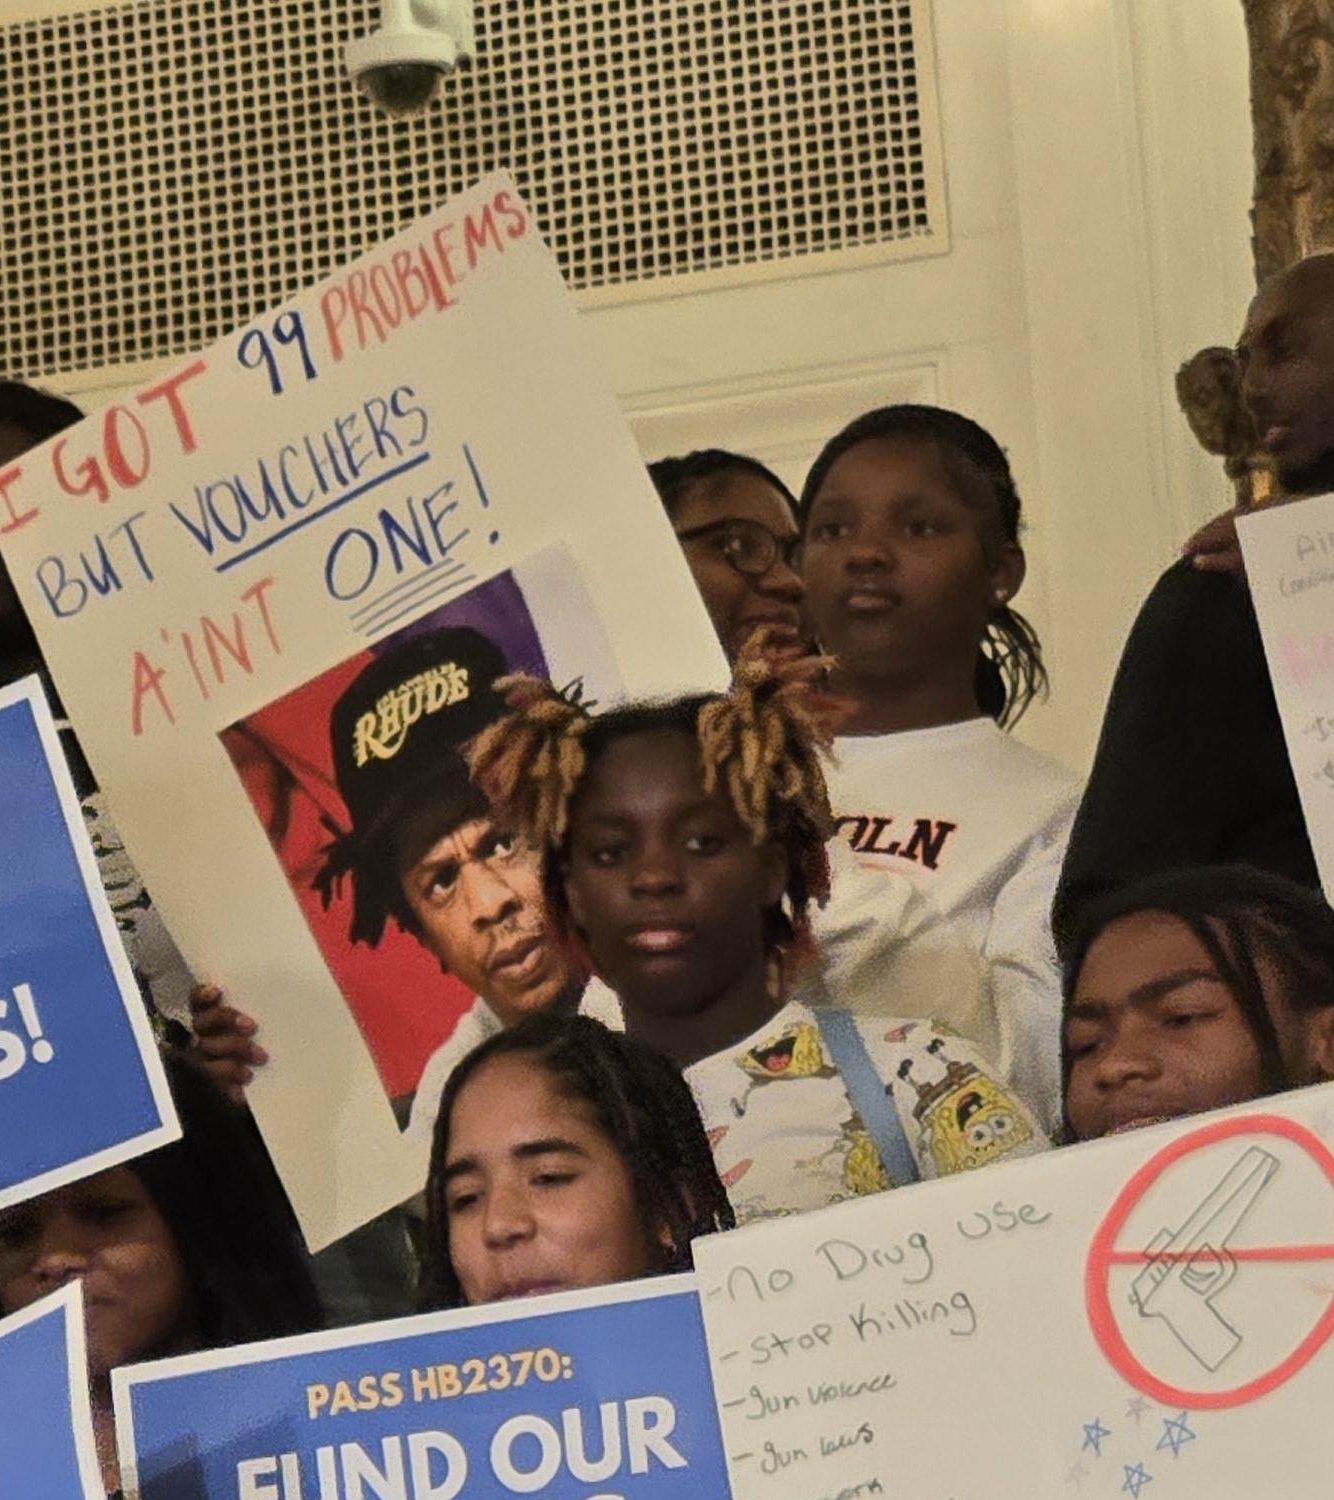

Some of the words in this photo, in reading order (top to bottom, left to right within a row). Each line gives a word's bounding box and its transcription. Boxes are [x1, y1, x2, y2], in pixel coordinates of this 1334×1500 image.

[51, 360, 209, 503] GOT
[237, 309, 318, 396] 99
[319, 189, 527, 361] PROBLEMS
[36, 510, 156, 620] BUT
[167, 385, 431, 555] VOUCHERS
[324, 441, 501, 602] ONE!
[353, 668, 470, 768] RHUDE
[815, 1232, 935, 1286] Drug
[307, 1371, 404, 1420] PASS
[411, 1346, 574, 1403] HB2370:
[490, 1395, 689, 1493] OUR
